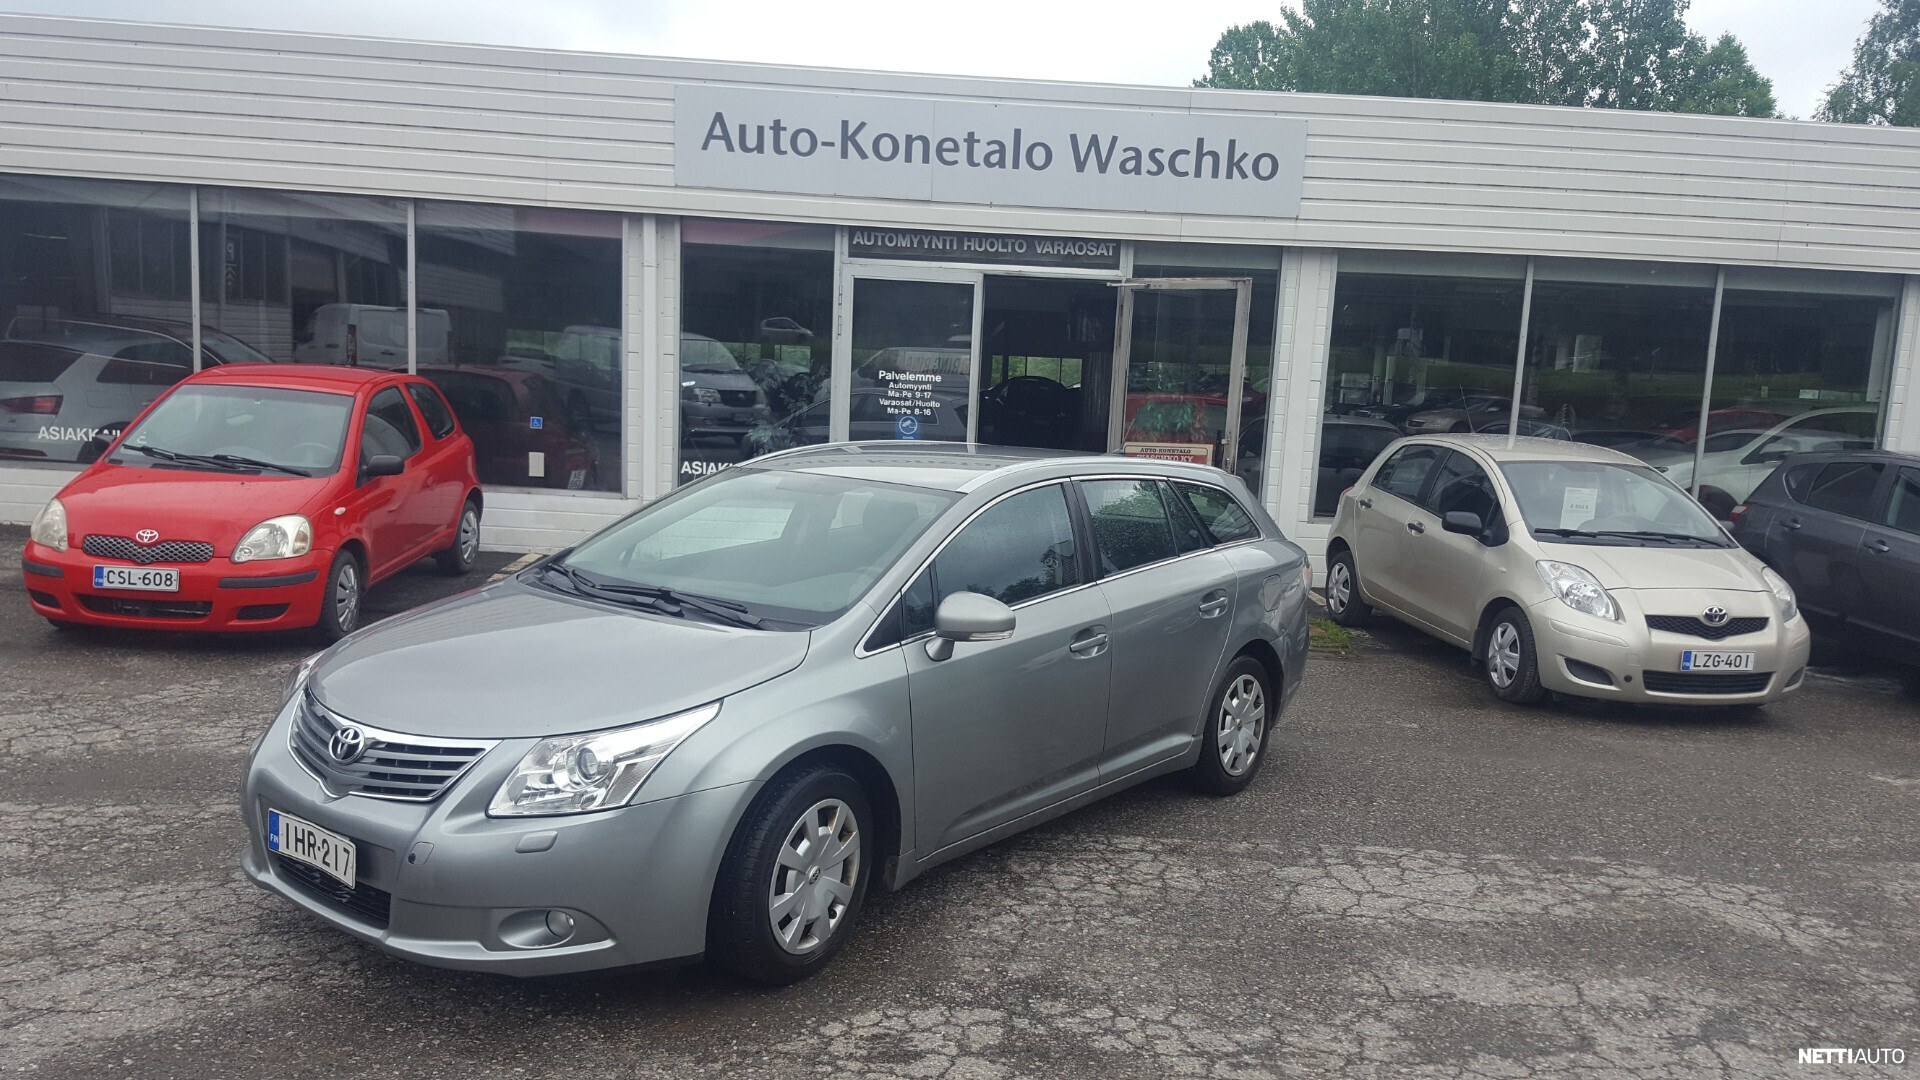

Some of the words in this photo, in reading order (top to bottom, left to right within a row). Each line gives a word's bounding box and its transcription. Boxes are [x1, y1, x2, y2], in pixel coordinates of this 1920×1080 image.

[701, 111, 1053, 172] Auto-Konetalo
[1069, 132, 1280, 182] Waschko
[852, 231, 957, 250] AUTOMYYNTI
[963, 237, 1027, 253] HUOLTO
[1034, 239, 1116, 257] VARAOSAT
[878, 370, 942, 382] Palvelemme
[888, 382, 932, 391] Automyynti
[887, 390, 912, 398] Ma-Pe
[915, 391, 932, 399] 9-17
[879, 398, 941, 408] Varaosat/Huolto
[887, 407, 912, 415] Ma-Pe
[914, 408, 931, 416] 8-16
[680, 460, 733, 475] ASIAK
[106, 569, 173, 587] CSL-608
[1693, 653, 1750, 669] LZG-401
[285, 822, 351, 876] IHR-217
